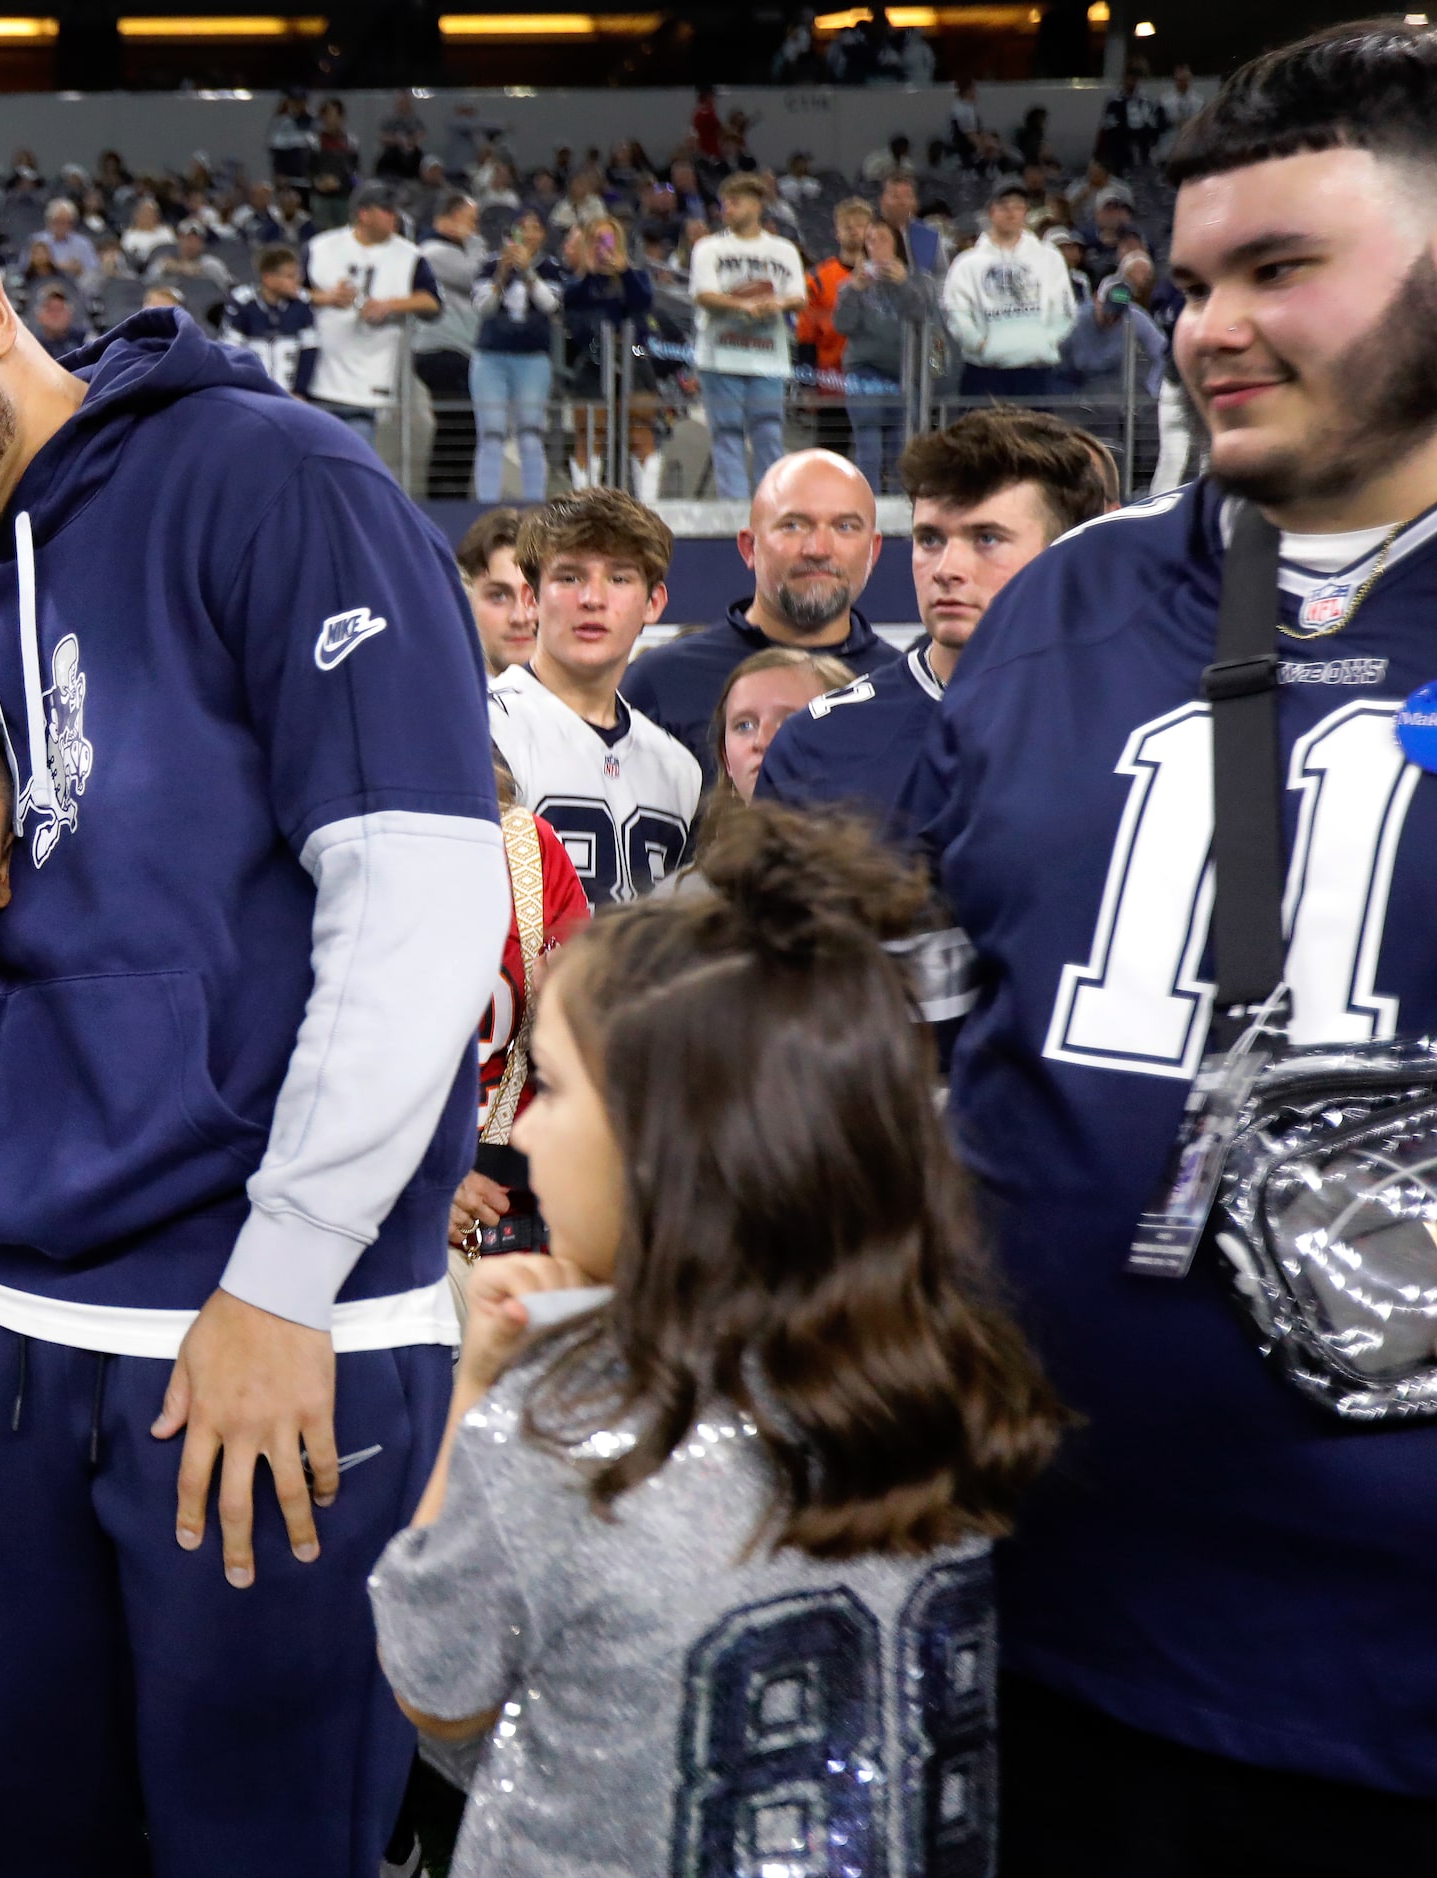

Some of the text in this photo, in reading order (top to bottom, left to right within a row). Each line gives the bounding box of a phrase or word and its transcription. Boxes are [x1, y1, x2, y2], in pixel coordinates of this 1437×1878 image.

[1306, 598, 1343, 622] NFL
[327, 614, 362, 646] NIKE
[1277, 658, 1389, 684] WBOYS
[1042, 699, 1421, 1080] 11
